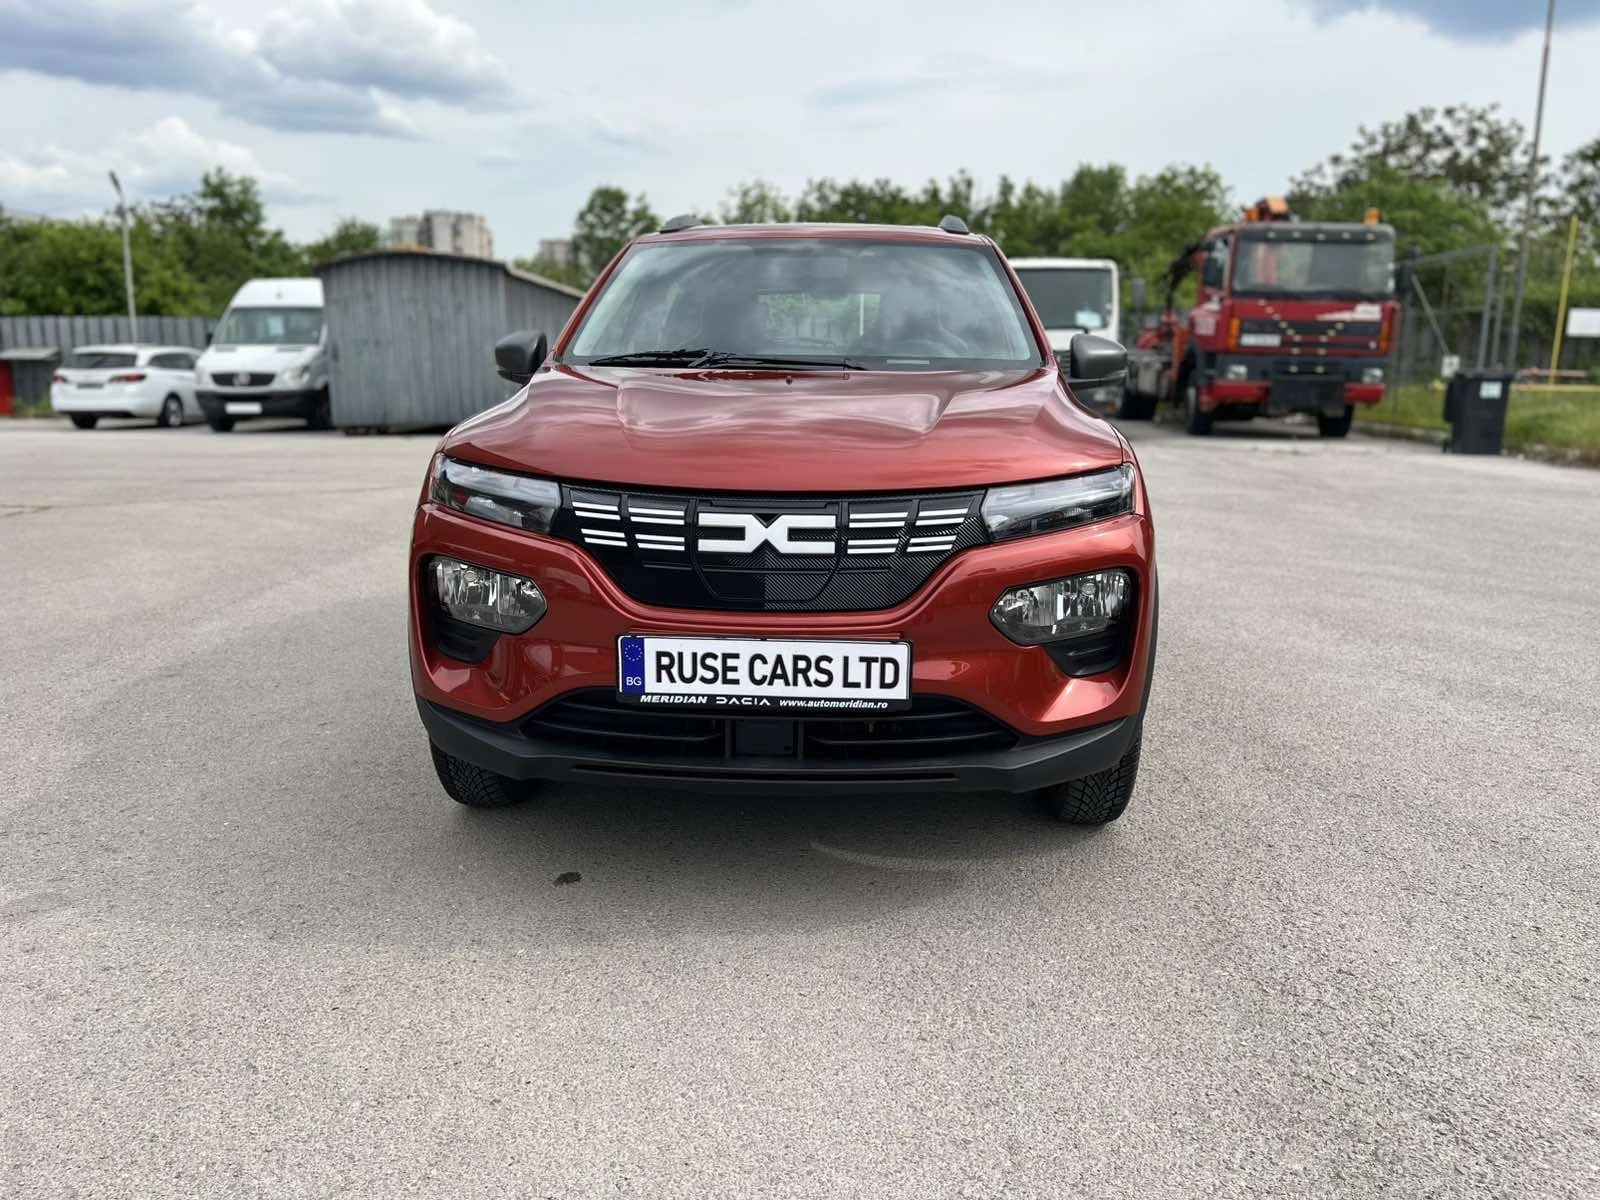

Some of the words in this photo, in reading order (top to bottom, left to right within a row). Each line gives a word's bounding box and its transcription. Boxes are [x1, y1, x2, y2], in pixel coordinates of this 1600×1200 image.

[655, 650, 741, 686] RUSE
[748, 653, 834, 688] CARS
[842, 655, 900, 689] LTD
[626, 676, 642, 687] BG
[640, 694, 707, 704] MERIDIAN
[716, 697, 771, 706] DACIA
[779, 699, 888, 710] www.automeridian.ro
